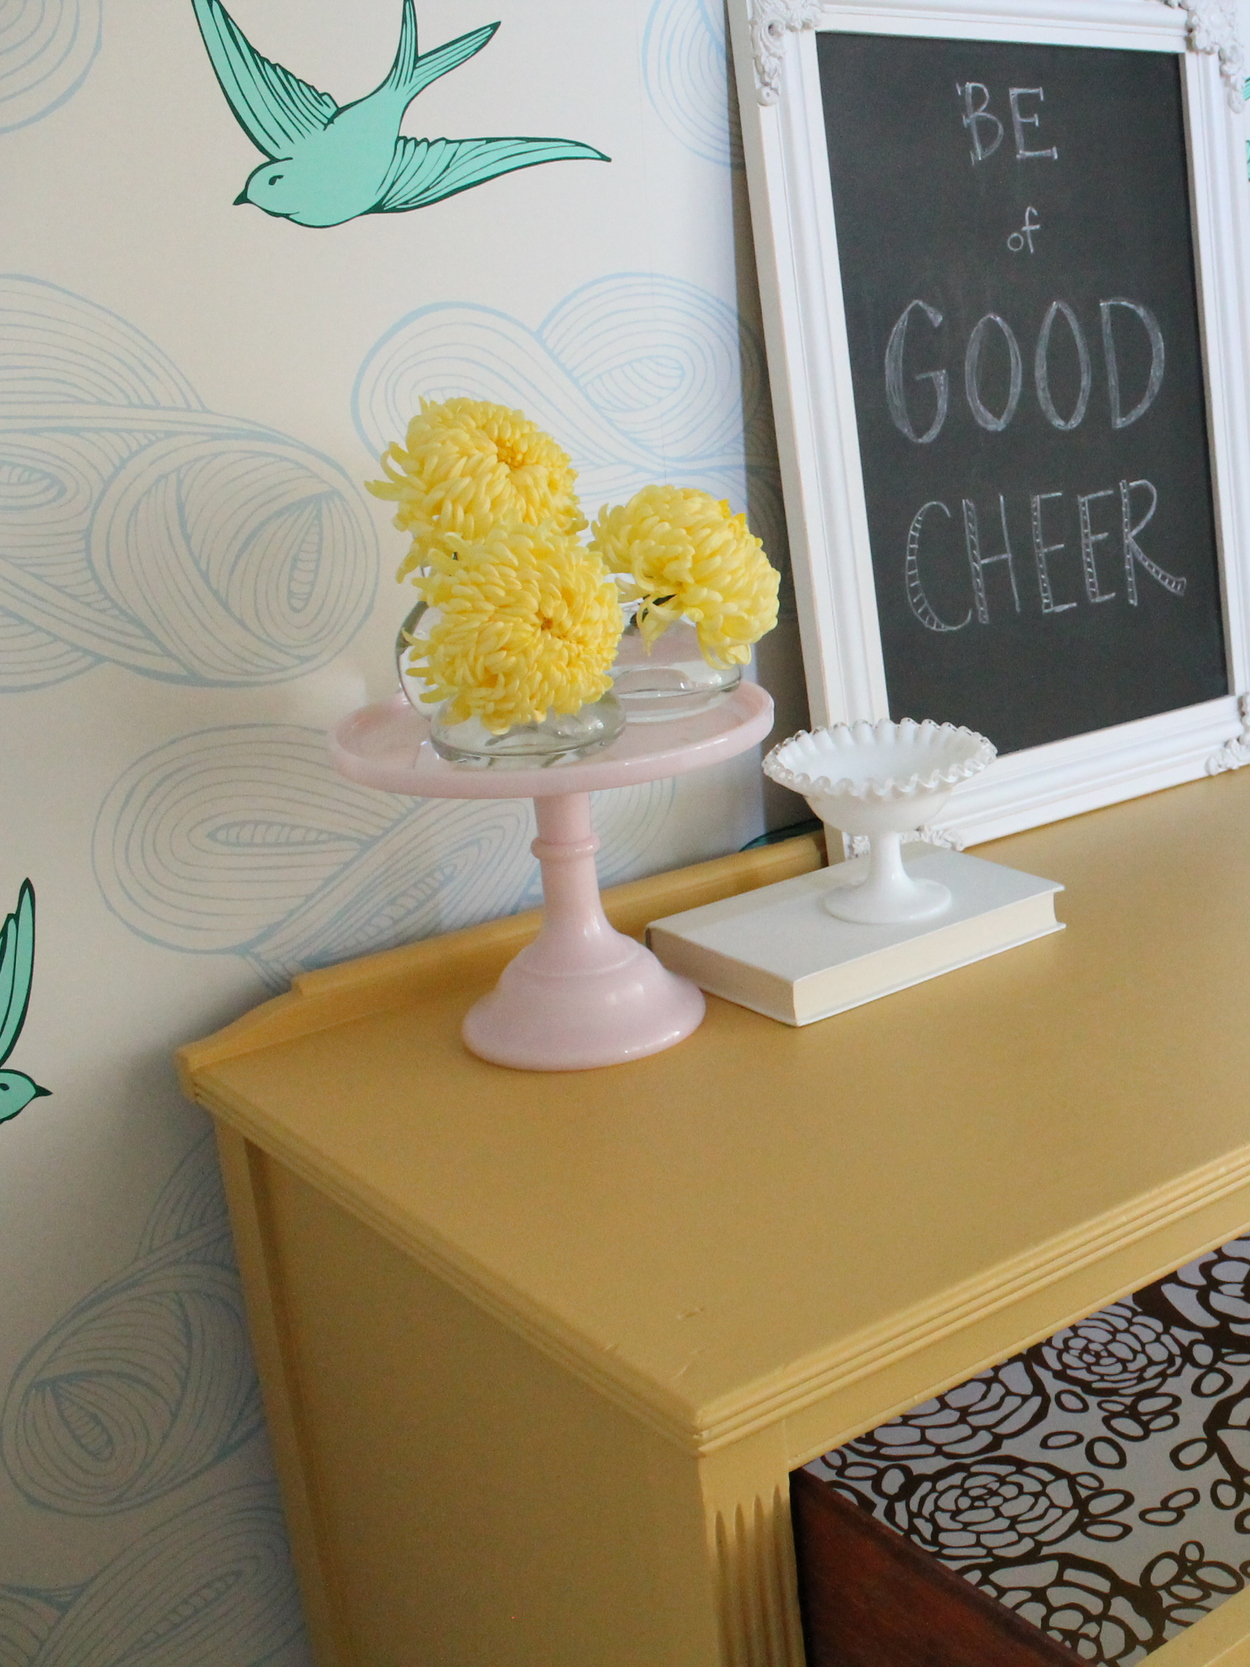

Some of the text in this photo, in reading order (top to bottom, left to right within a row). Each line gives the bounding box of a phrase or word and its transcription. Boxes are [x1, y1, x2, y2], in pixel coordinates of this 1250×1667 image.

[956, 82, 1058, 165] BE
[1007, 206, 1040, 253] of
[885, 299, 1164, 443] GOOD
[905, 479, 1186, 632] CHEER
